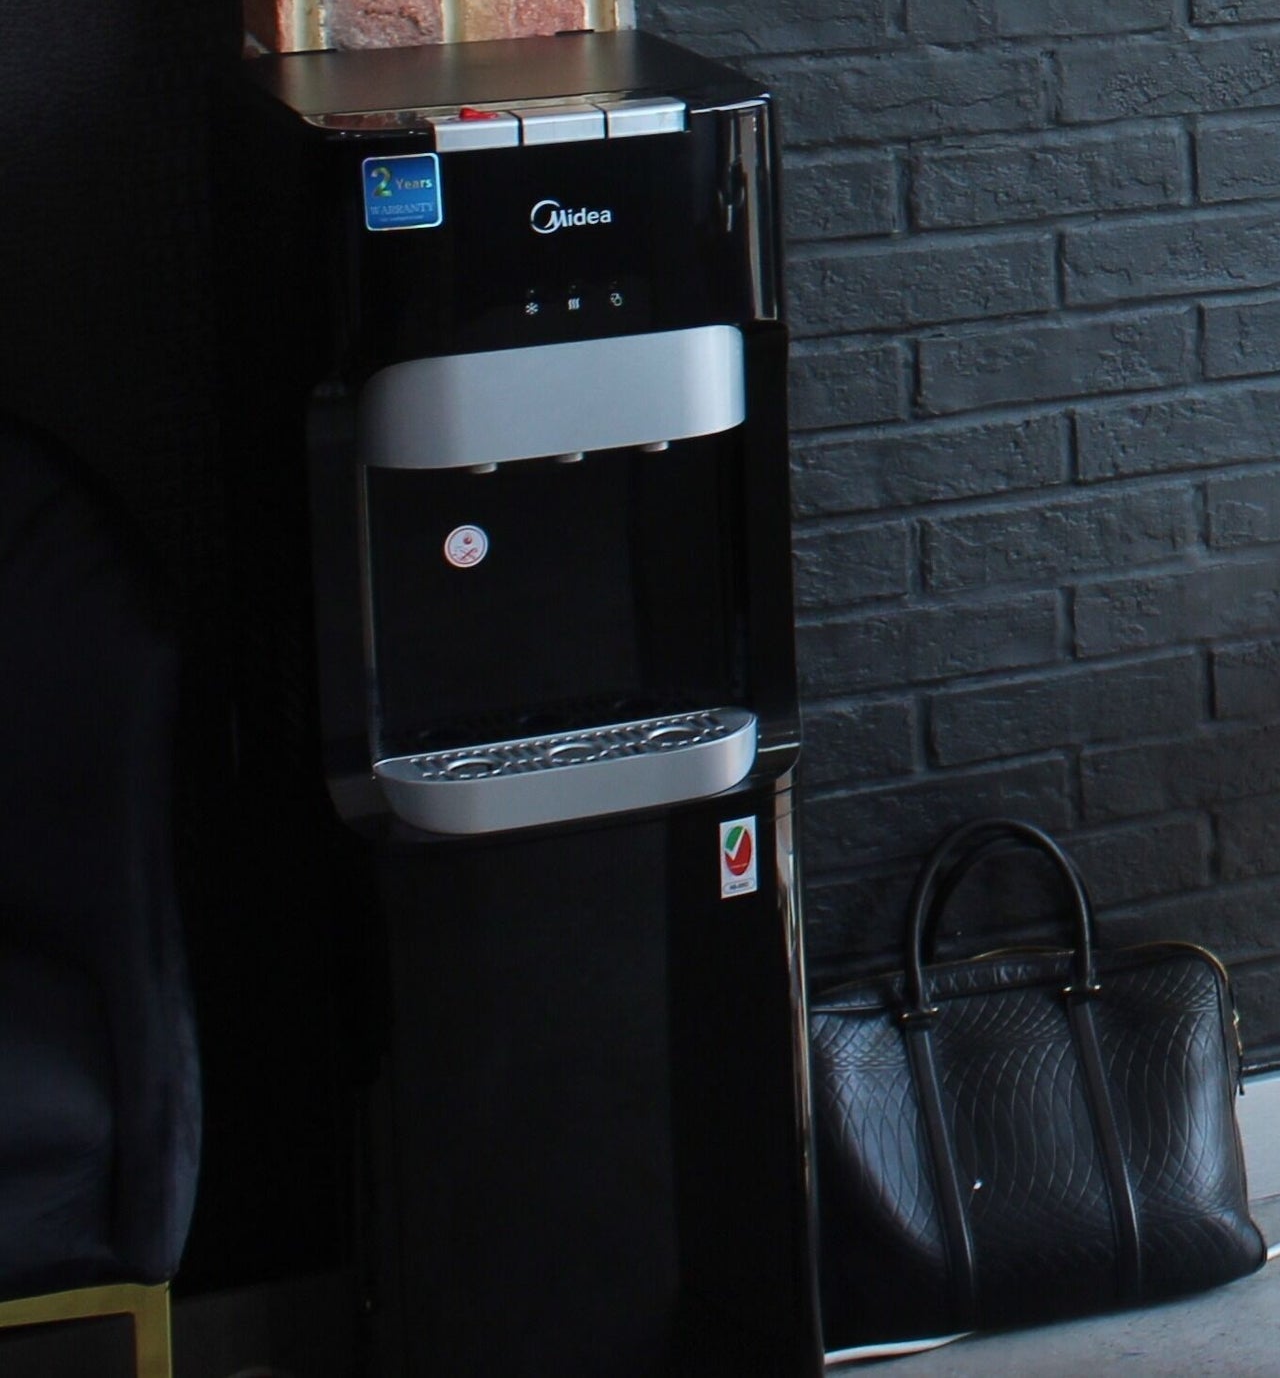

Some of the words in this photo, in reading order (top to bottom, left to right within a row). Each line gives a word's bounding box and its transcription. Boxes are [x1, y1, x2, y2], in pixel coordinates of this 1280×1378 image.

[371, 167, 392, 198] 2
[395, 177, 433, 190] Years
[371, 202, 434, 215] WARRANTY
[531, 199, 612, 234] Midea
